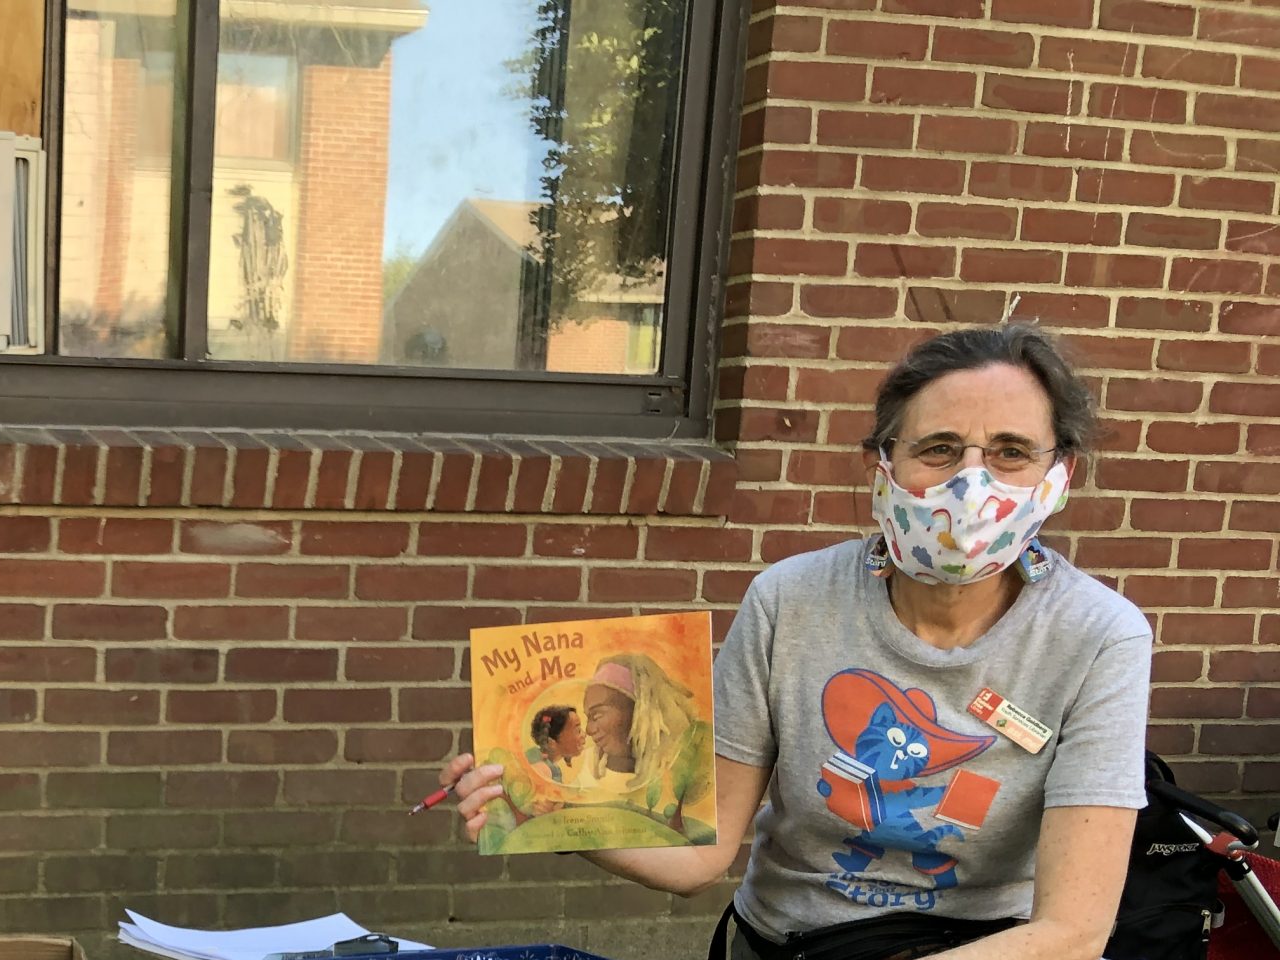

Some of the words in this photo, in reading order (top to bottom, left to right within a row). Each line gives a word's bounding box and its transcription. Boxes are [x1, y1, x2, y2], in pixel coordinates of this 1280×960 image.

[481, 645, 522, 676] My
[521, 631, 584, 658] Nana
[508, 673, 533, 695] and
[540, 656, 577, 682] Me
